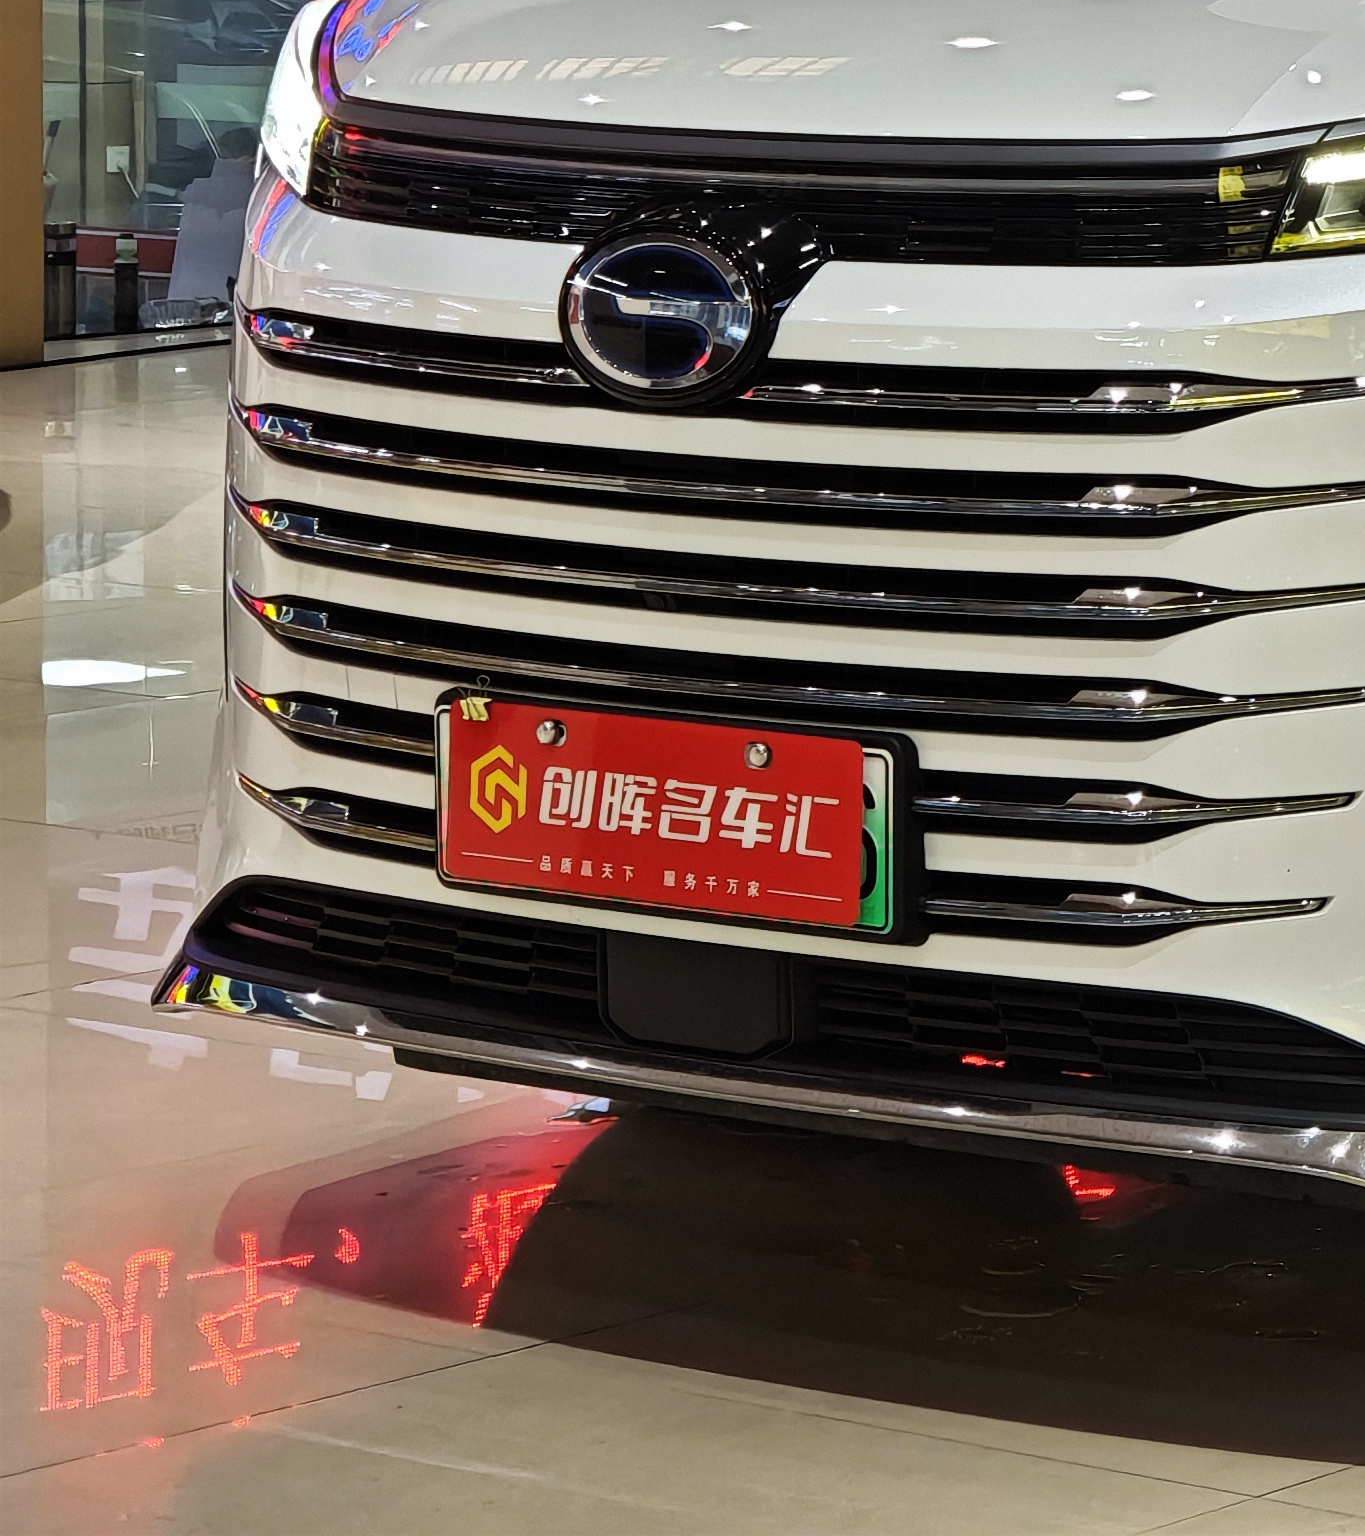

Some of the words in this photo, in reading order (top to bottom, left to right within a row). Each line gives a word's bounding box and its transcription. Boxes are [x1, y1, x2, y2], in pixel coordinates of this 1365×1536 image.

[538, 765, 840, 860] 创晖名车汇
